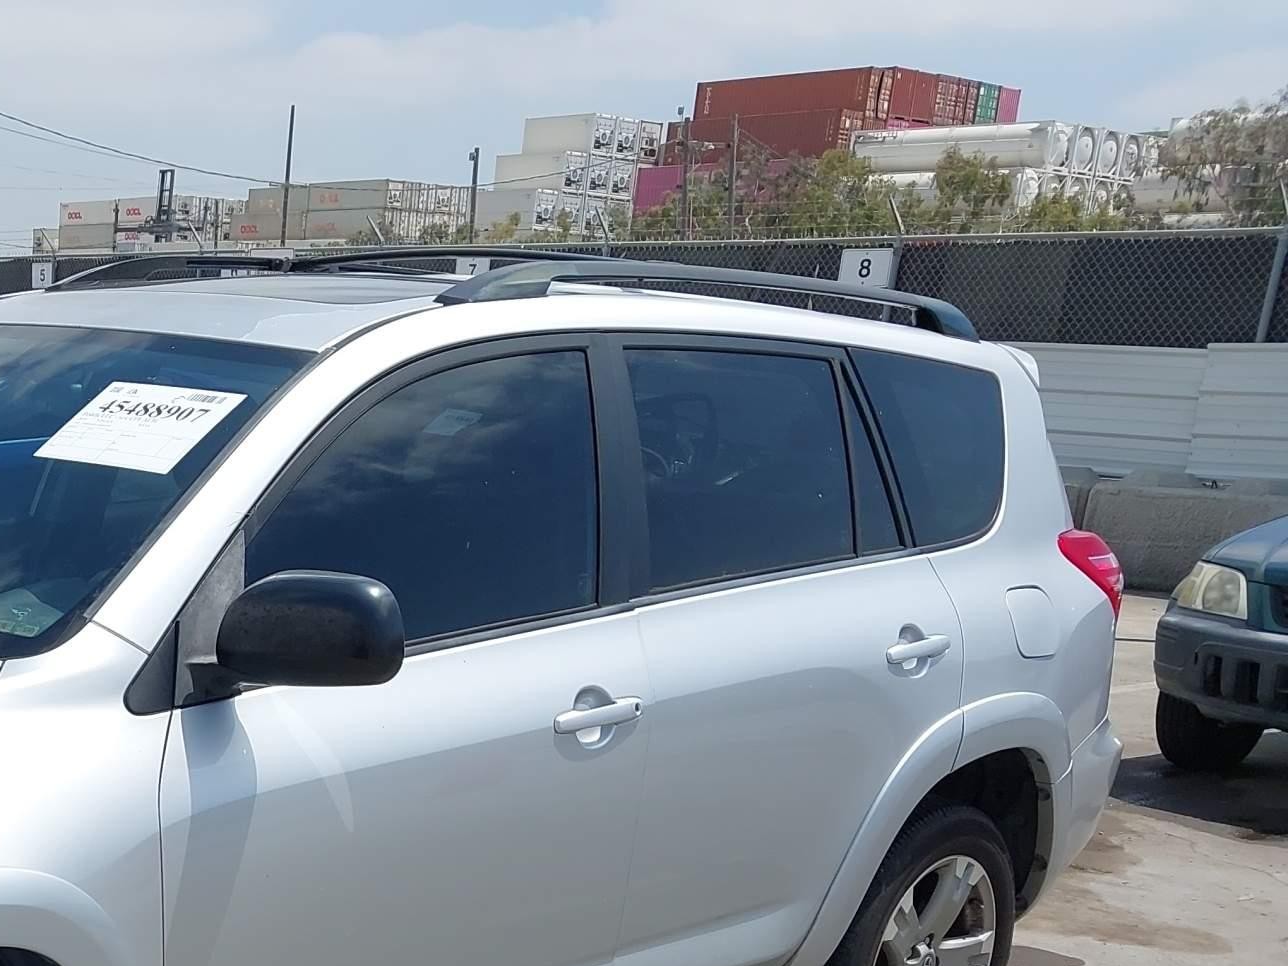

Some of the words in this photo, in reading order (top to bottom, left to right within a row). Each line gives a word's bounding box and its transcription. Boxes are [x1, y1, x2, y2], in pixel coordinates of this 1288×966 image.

[68, 212, 82, 220] OOCL
[126, 208, 141, 216] OOCL
[240, 224, 258, 234] OOCL
[469, 263, 478, 275] 7
[858, 258, 872, 278] 8
[40, 268, 46, 282] 5
[99, 399, 211, 423] 45488907
